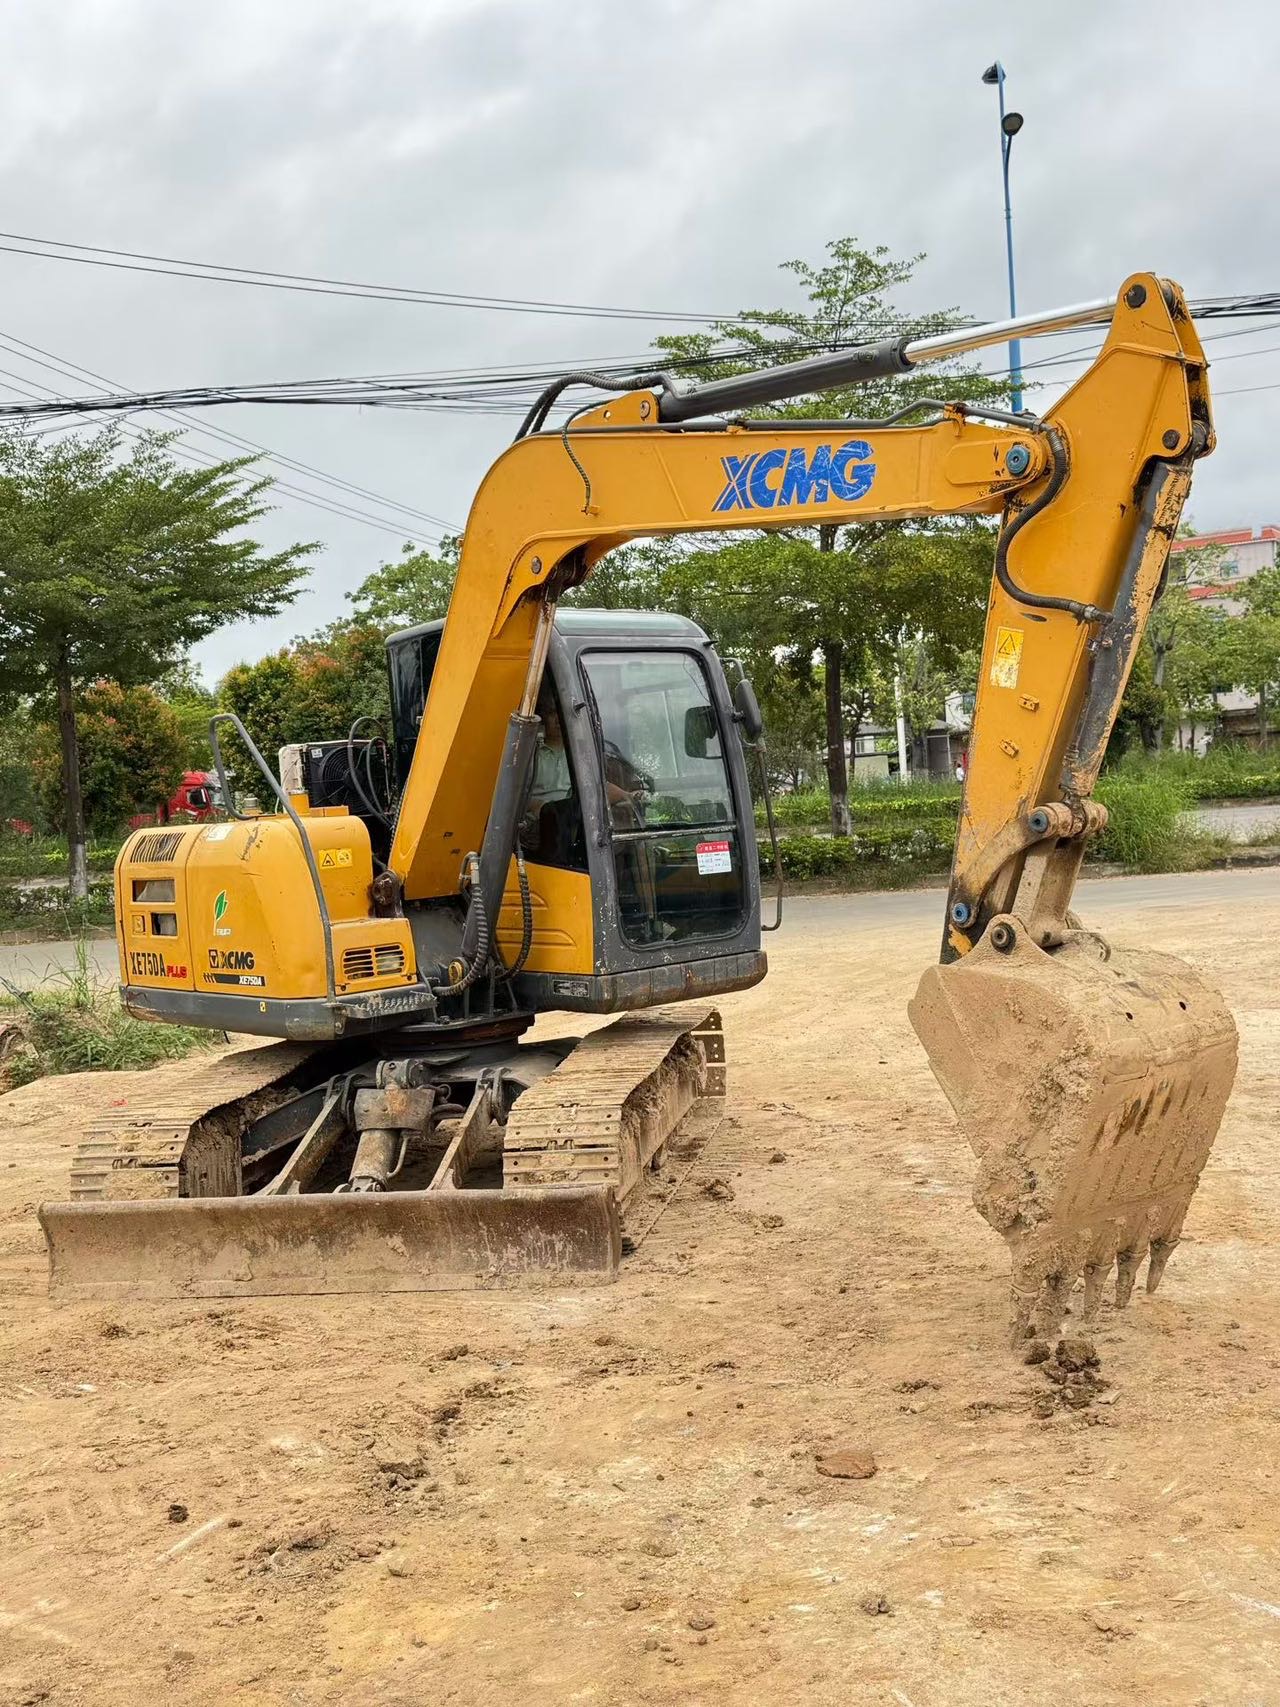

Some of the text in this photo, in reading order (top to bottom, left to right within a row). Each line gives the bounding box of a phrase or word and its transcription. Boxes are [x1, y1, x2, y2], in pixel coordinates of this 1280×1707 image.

[711, 440, 876, 512] XCMG
[130, 951, 166, 977] XE75DA
[219, 950, 255, 970] XCMG
